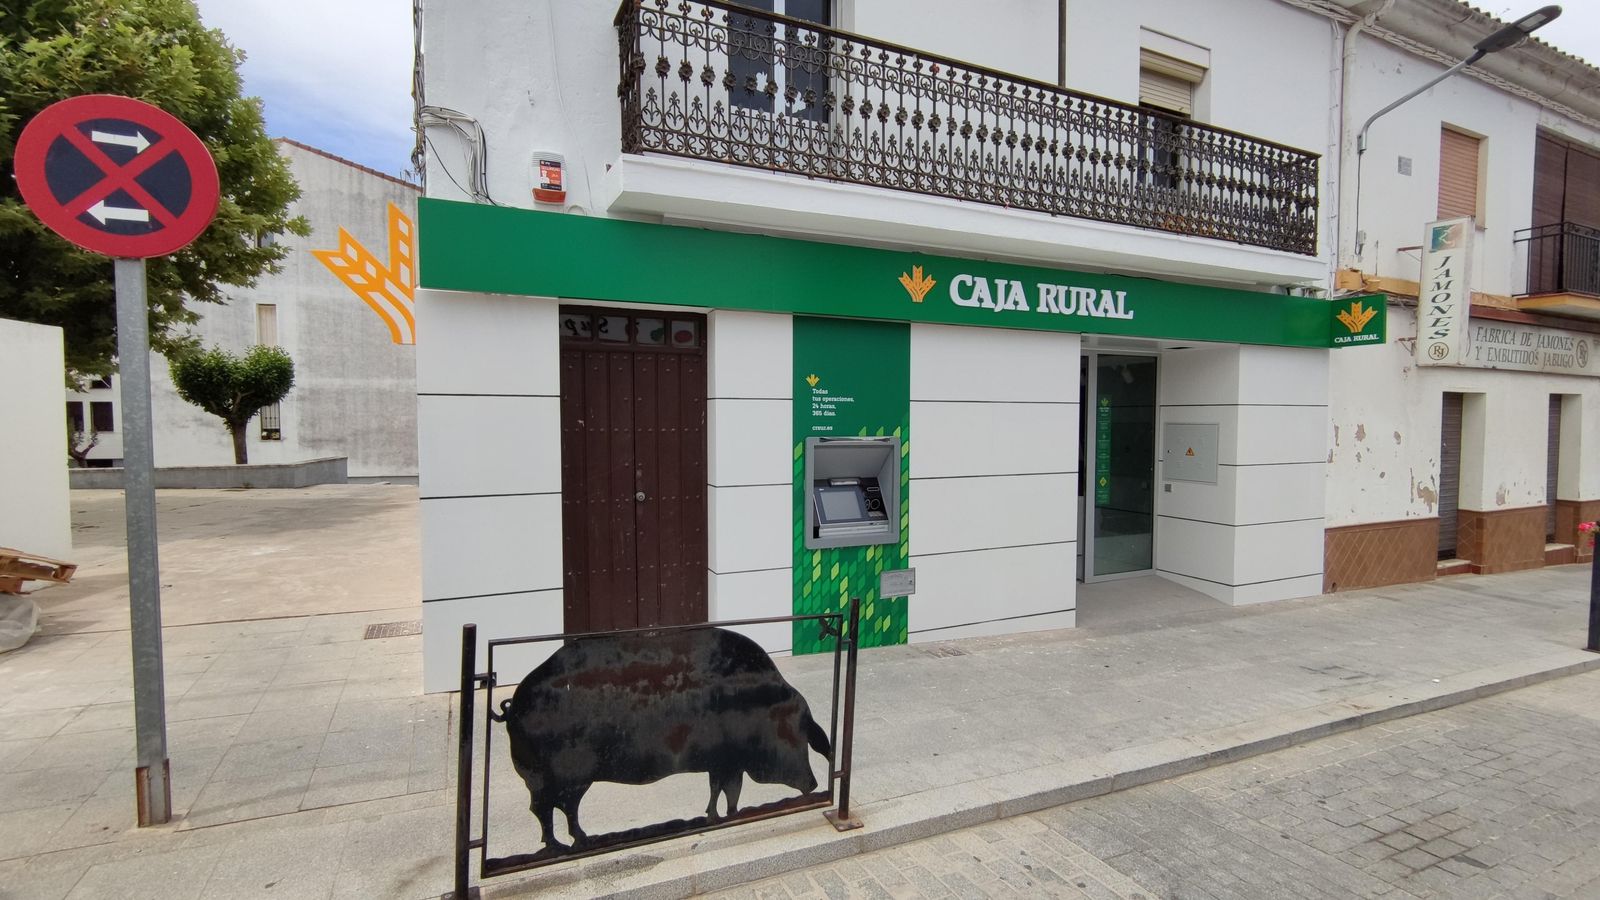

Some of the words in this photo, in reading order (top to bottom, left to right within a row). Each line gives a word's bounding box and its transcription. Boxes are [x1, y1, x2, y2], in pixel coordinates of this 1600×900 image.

[950, 274, 1029, 312] CAJA
[1036, 283, 1134, 320] RURAL
[1427, 256, 1455, 339] JAMONES
[1476, 326, 1516, 345] FABRICA
[1520, 332, 1533, 346] DE
[1536, 334, 1574, 351] JAMONES
[1476, 346, 1482, 360] Y
[1487, 347, 1539, 366] EMBUTIDOS
[1542, 352, 1574, 369] JABUGO
